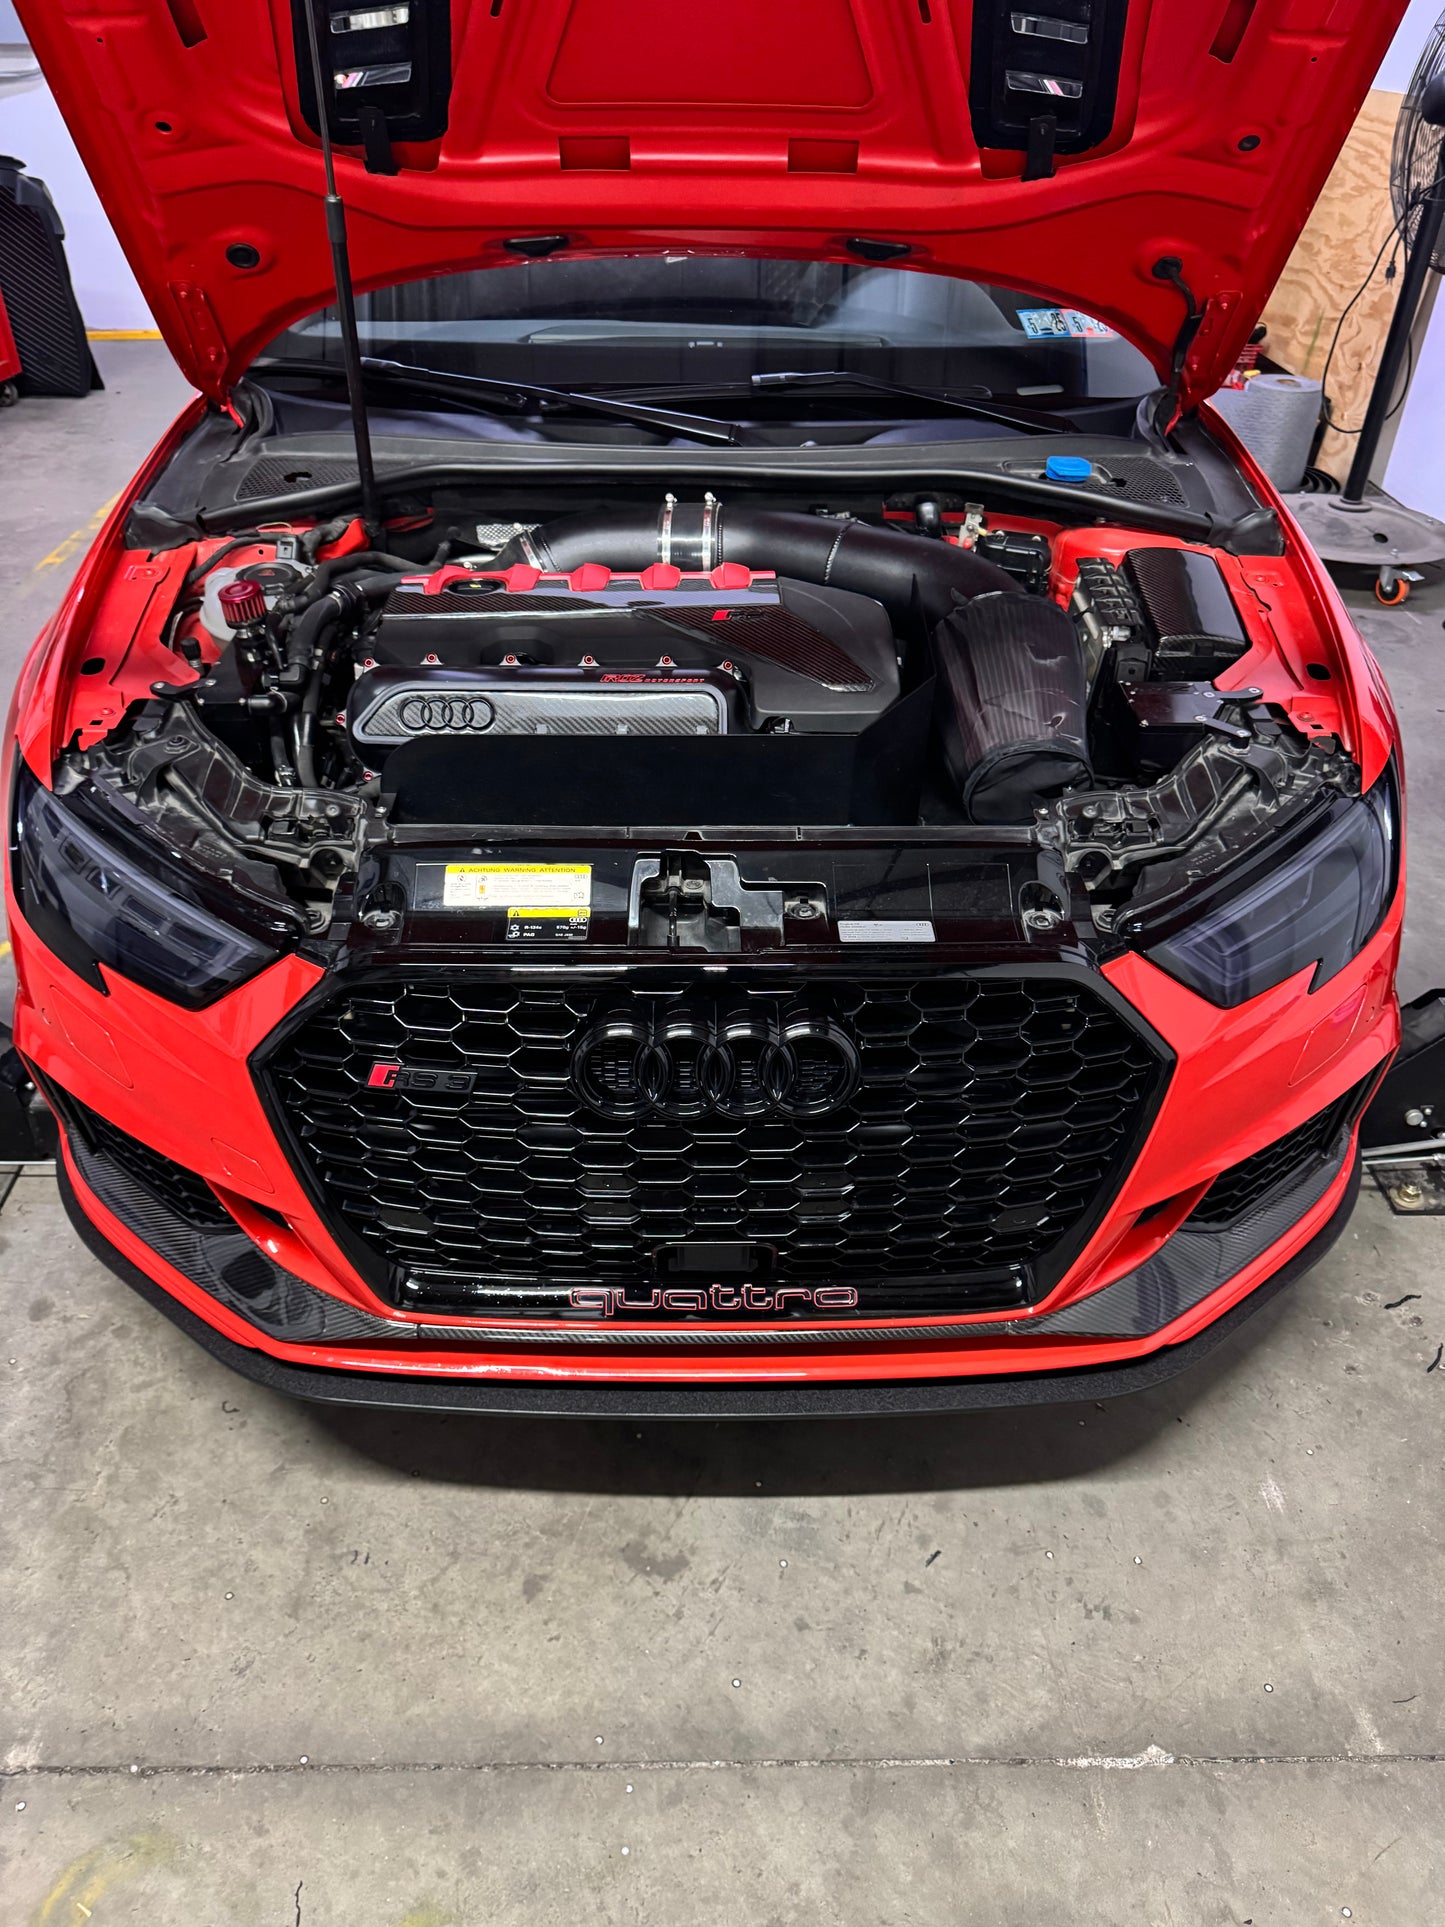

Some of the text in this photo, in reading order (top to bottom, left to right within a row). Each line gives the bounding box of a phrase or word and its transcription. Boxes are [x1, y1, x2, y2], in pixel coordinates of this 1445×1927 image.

[1027, 318, 1039, 334] 5
[1072, 316, 1083, 333] 5
[569, 1284, 858, 1315] quattro
